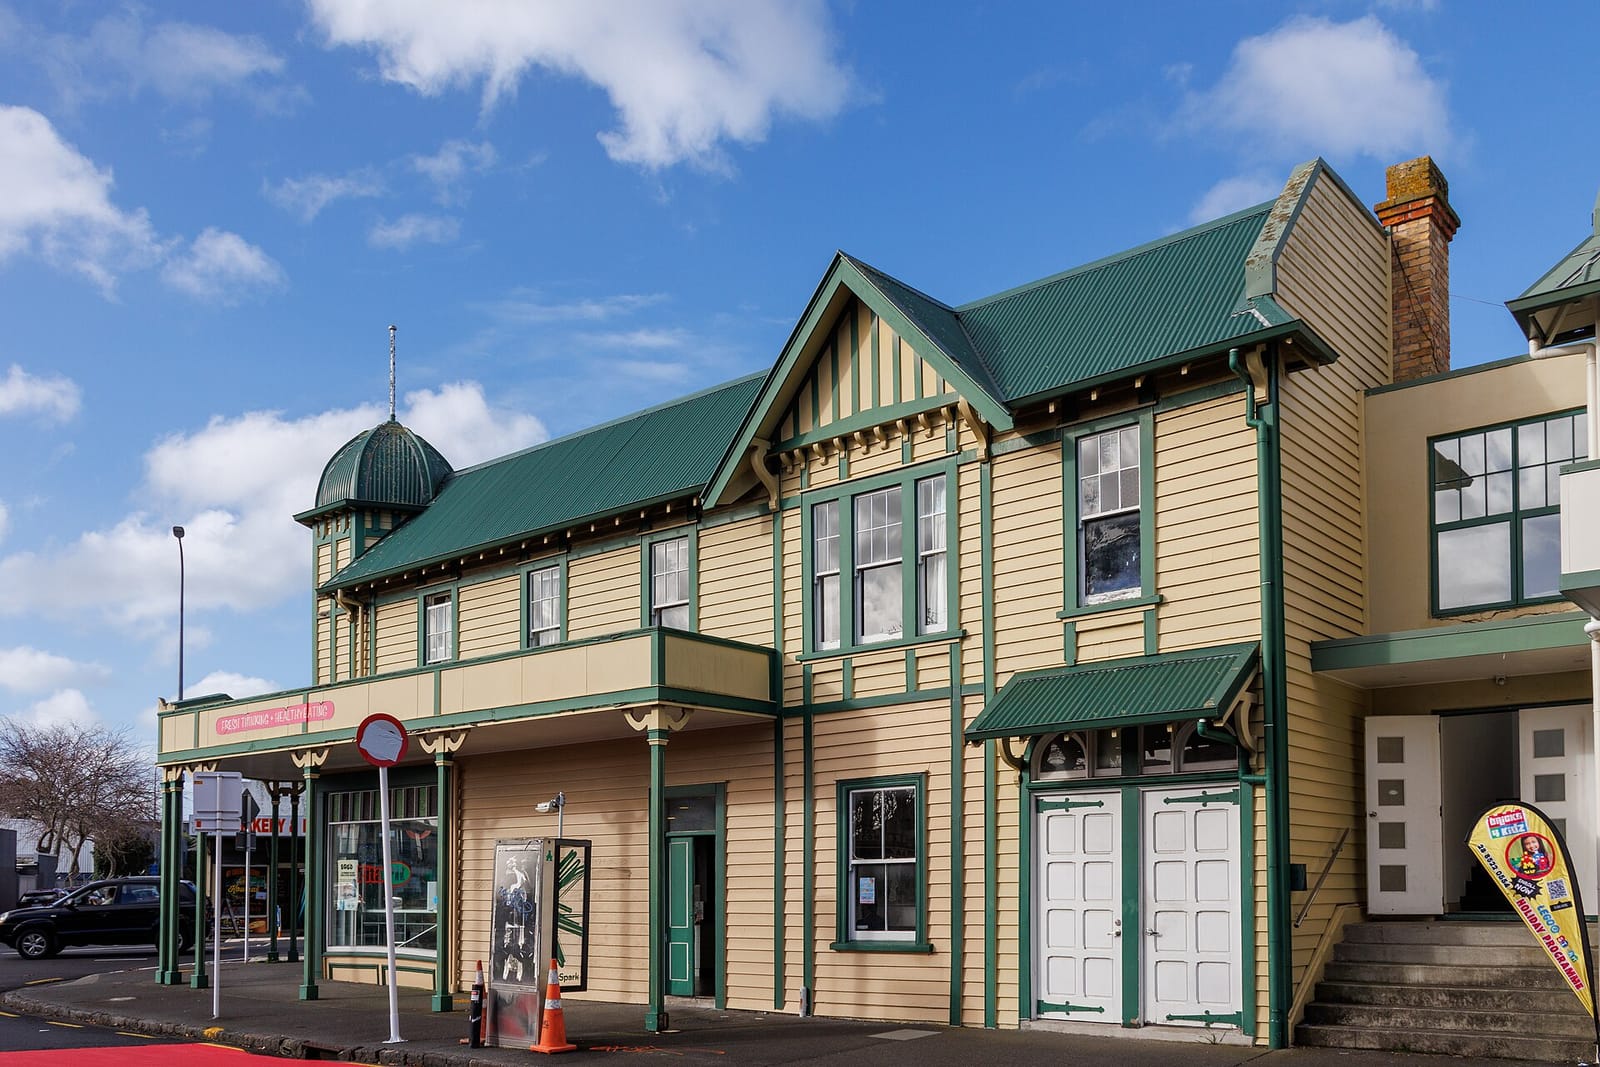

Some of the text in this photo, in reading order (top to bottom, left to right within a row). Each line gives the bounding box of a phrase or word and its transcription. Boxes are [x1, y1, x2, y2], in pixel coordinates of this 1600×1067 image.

[221, 704, 328, 732] FRESH THINKING HEALTHY EATING
[1514, 883, 1534, 895] NOW
[1516, 898, 1546, 933] HOLIDAY
[1542, 934, 1584, 991] PROGRAMME
[558, 971, 579, 983] Spark
